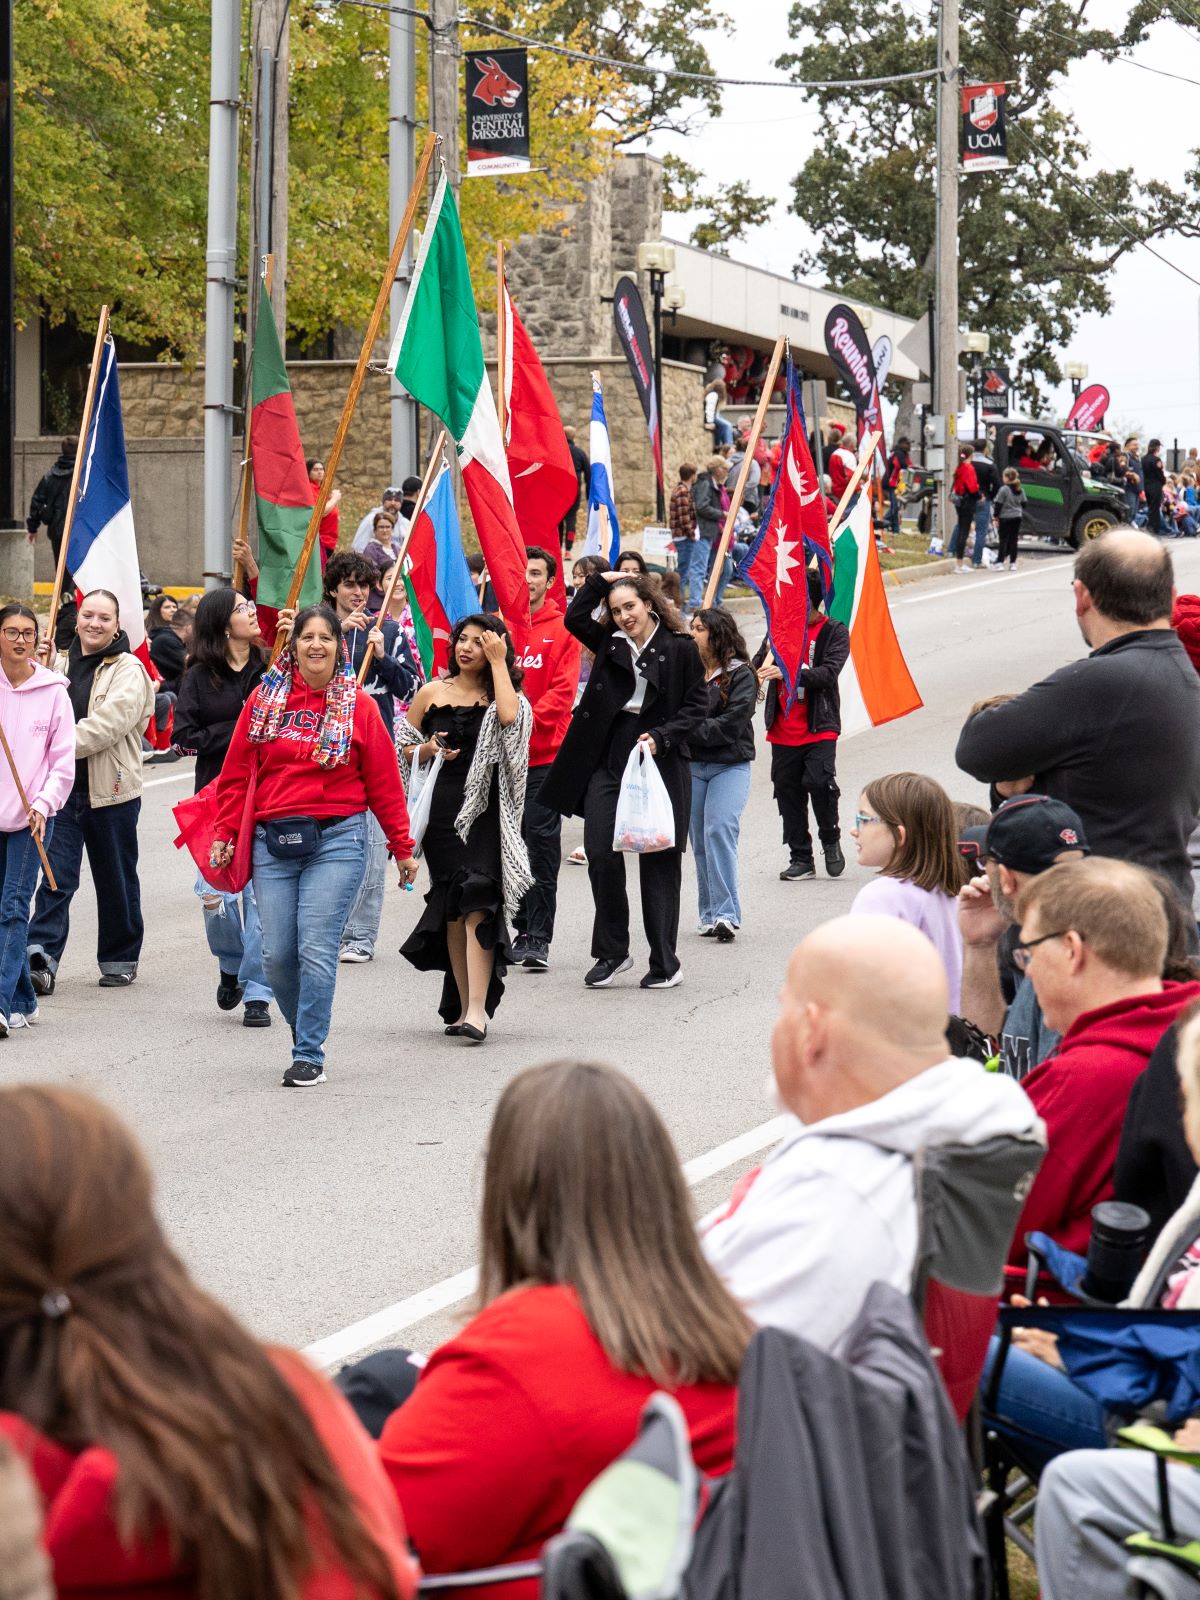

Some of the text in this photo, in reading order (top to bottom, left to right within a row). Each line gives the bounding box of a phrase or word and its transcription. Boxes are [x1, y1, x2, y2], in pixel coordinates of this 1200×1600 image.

[473, 112, 523, 121] UNIVERSITY OF
[472, 119, 524, 133] CENTRAL
[472, 126, 525, 140] MISSOURI
[968, 133, 1002, 149] UCM
[477, 163, 520, 171] COMMUNITY
[830, 317, 872, 396] Reunion
